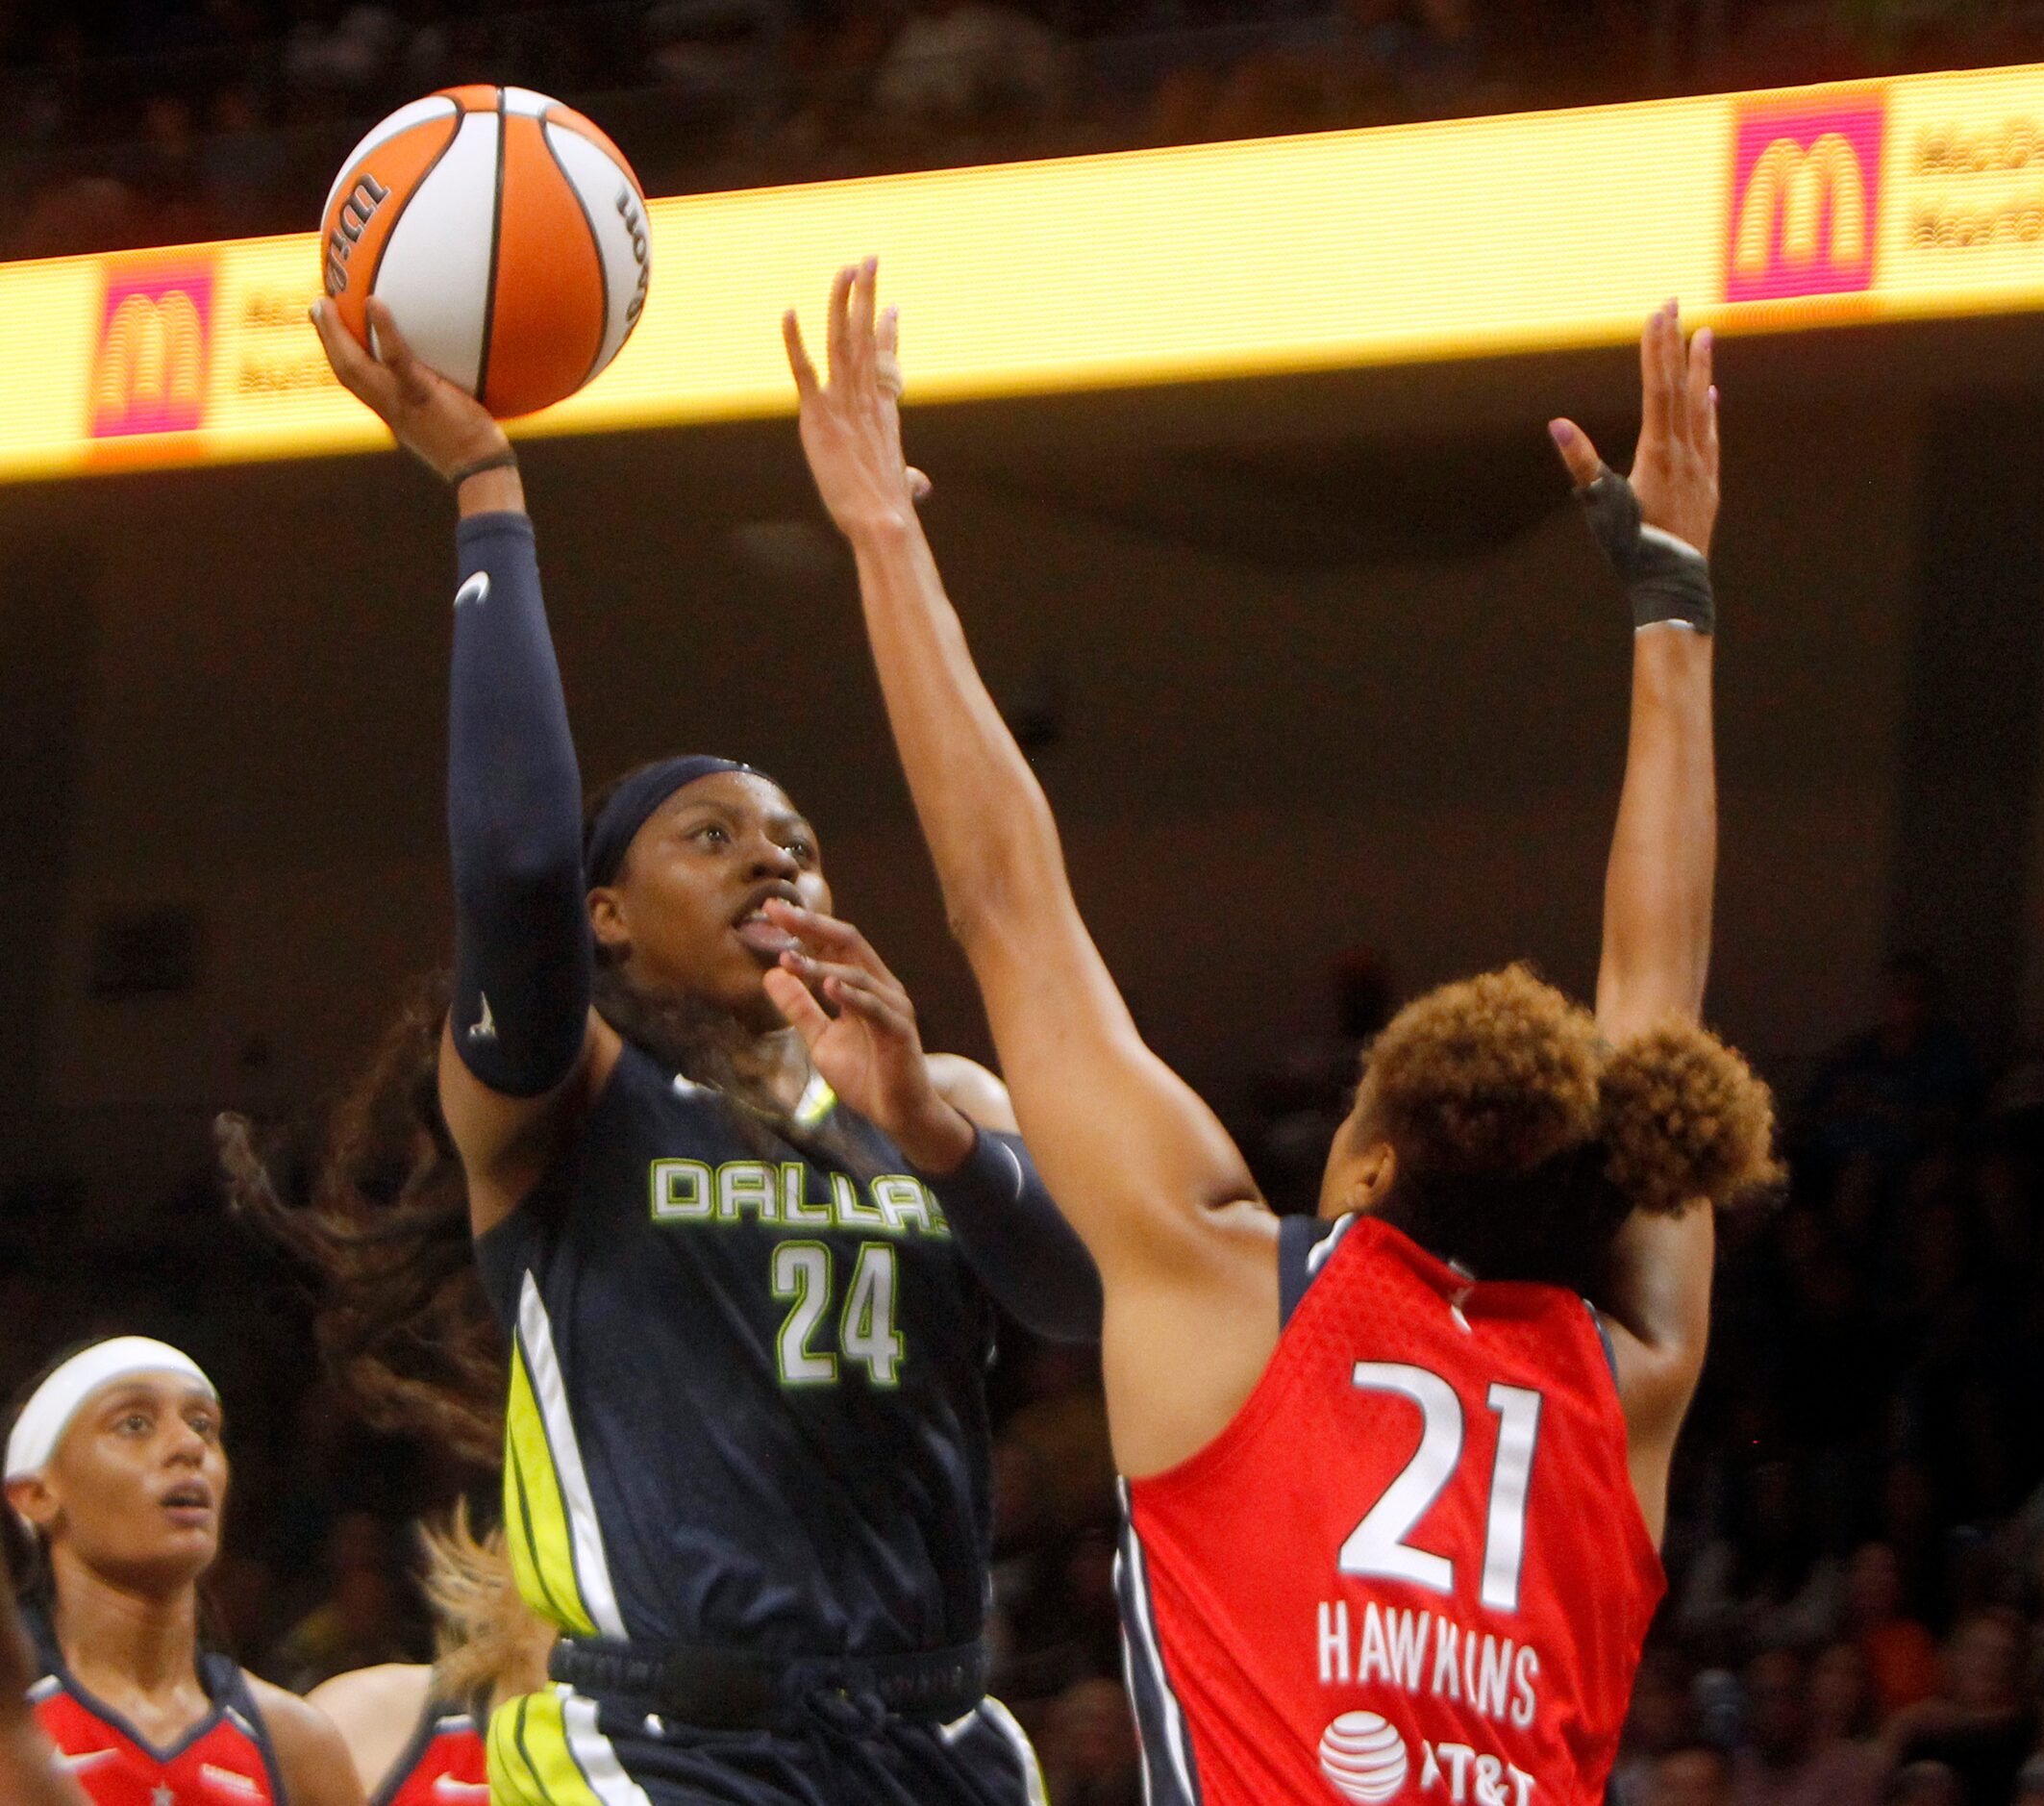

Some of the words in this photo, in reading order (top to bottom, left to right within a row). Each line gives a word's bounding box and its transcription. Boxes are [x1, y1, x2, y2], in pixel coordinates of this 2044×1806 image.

[771, 1239, 906, 1385] 24
[1338, 1360, 1542, 1612] 21
[1317, 1599, 1539, 1728] HAWKINS
